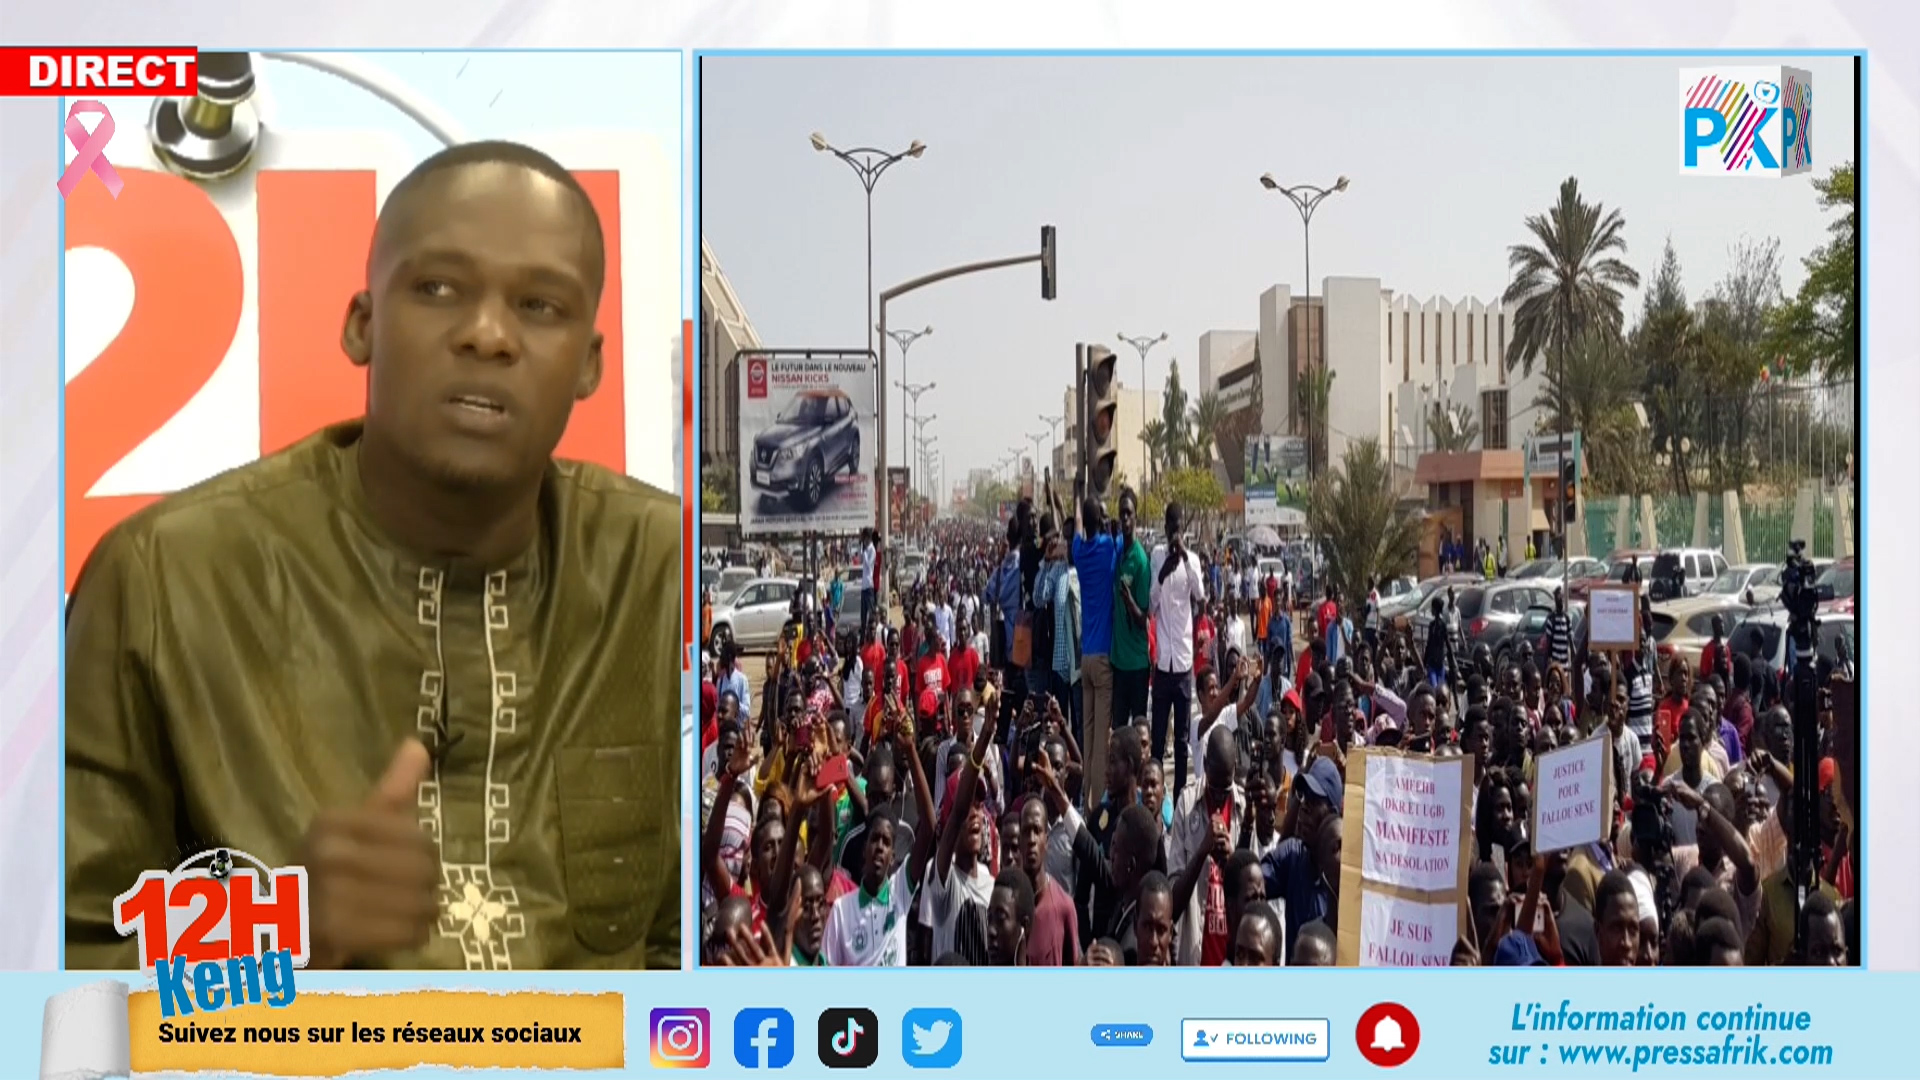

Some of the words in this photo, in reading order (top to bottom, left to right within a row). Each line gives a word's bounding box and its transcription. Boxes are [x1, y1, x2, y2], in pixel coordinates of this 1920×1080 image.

[771, 363, 778, 372] LE
[781, 363, 803, 372] FUTUR
[805, 363, 823, 372] DANS
[825, 363, 832, 372] LE
[834, 363, 866, 372] NOUVEAU
[771, 373, 803, 383] NISSAN
[805, 373, 829, 383] KICKS
[1553, 759, 1586, 779] JUSTICE
[1558, 783, 1580, 800] POUR
[1423, 803, 1445, 819] UGB)
[1541, 806, 1572, 825] FALLOU
[1375, 820, 1449, 847] MANIFESTE
[1375, 850, 1388, 866] SA
[1390, 853, 1450, 873] DESOLATION
[1390, 919, 1404, 936] JE
[1407, 922, 1433, 943] SUIS
[1368, 942, 1418, 967] FALLOU
